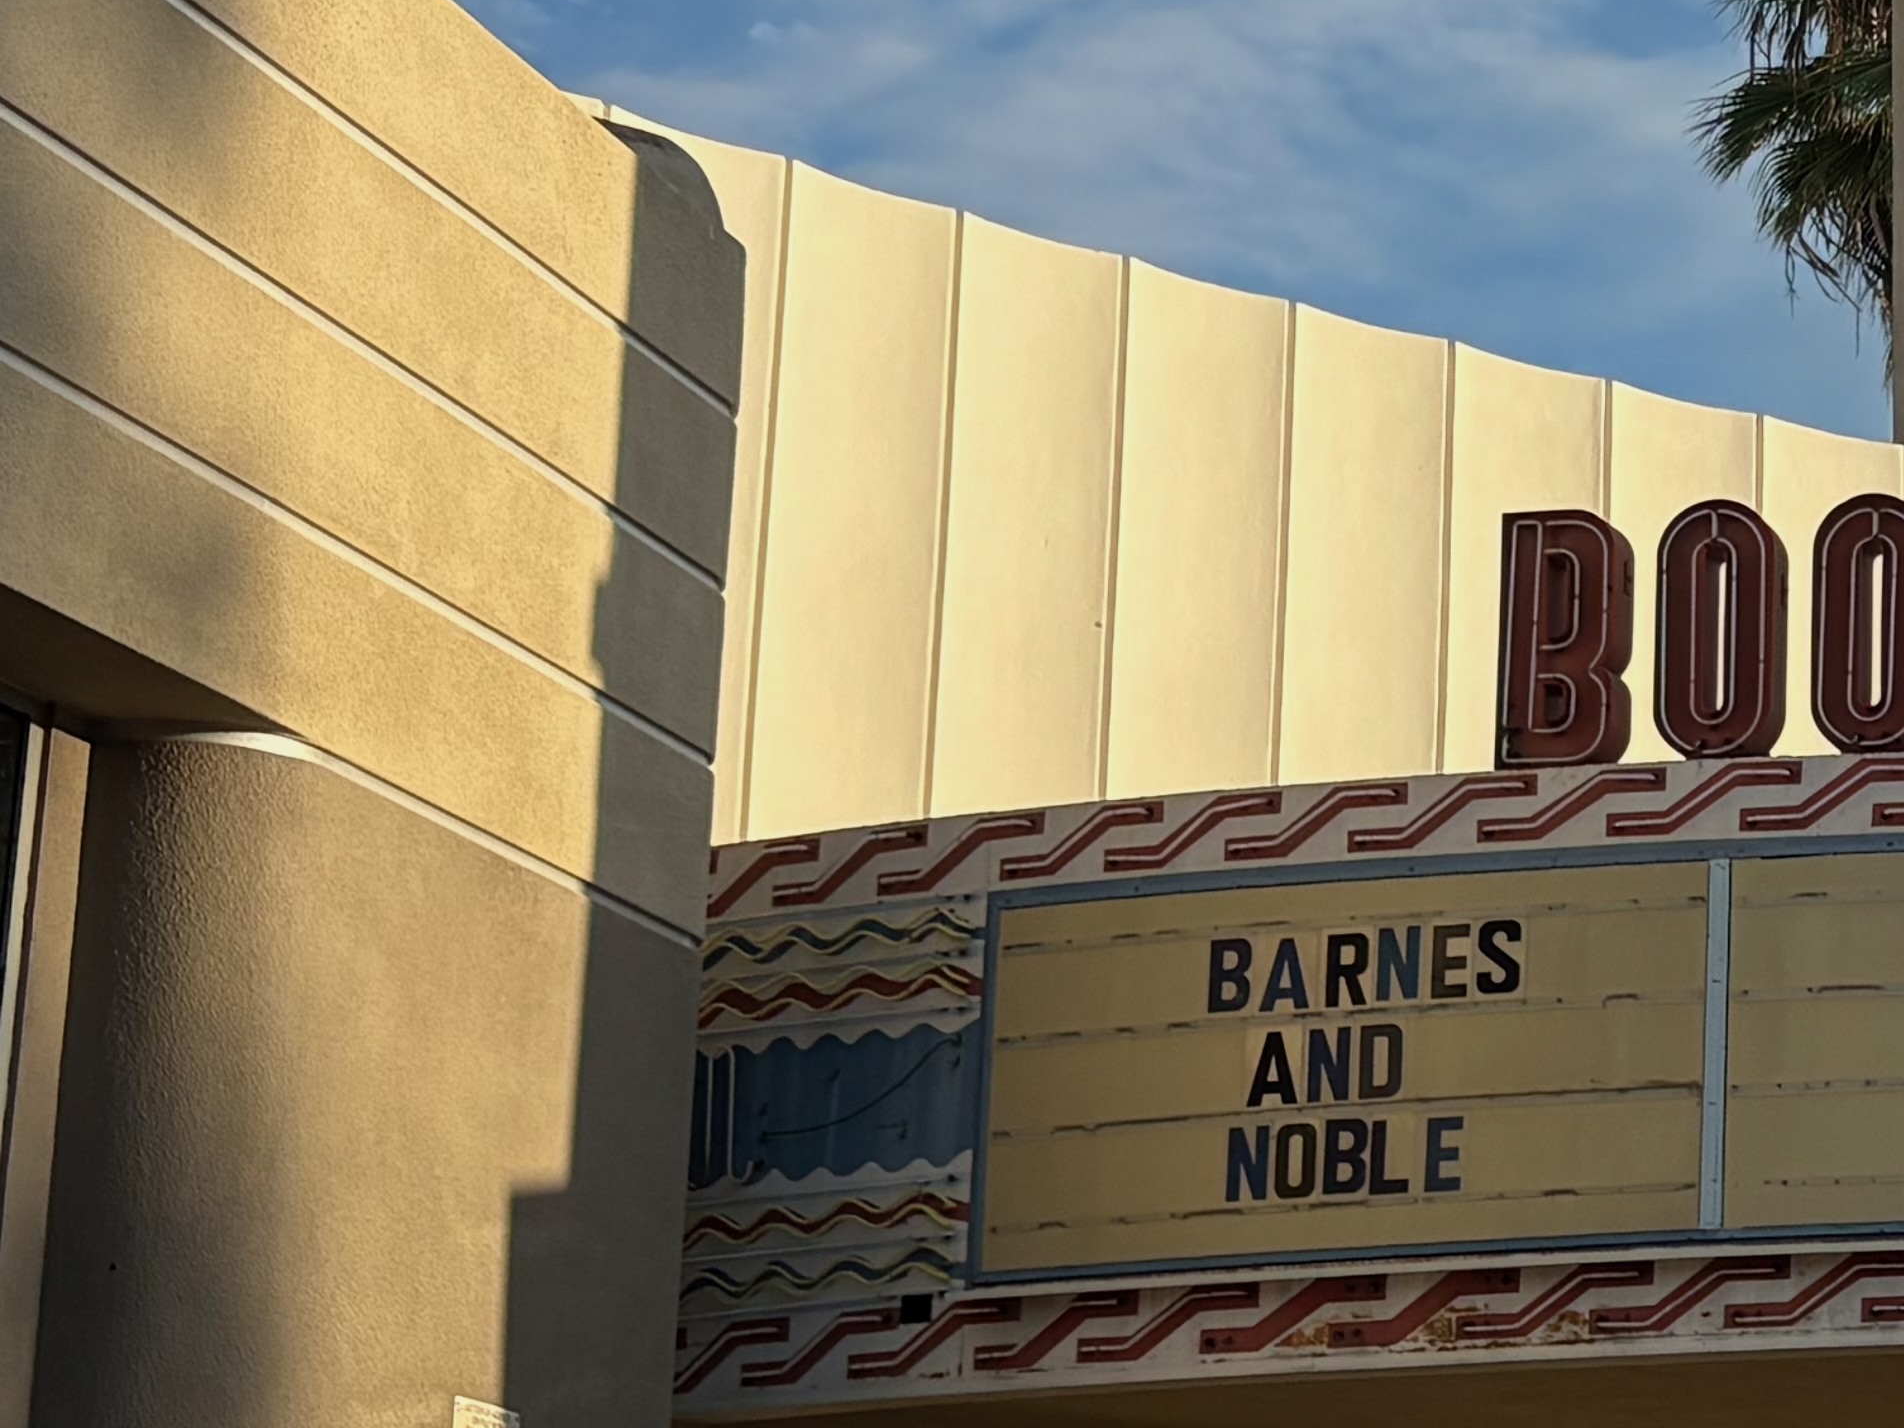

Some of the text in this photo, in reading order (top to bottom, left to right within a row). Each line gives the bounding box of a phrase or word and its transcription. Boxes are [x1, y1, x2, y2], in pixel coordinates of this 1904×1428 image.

[1208, 919, 1522, 1013] BARNES
[1247, 1023, 1404, 1108] AND
[1225, 1115, 1464, 1202] NOBLE
